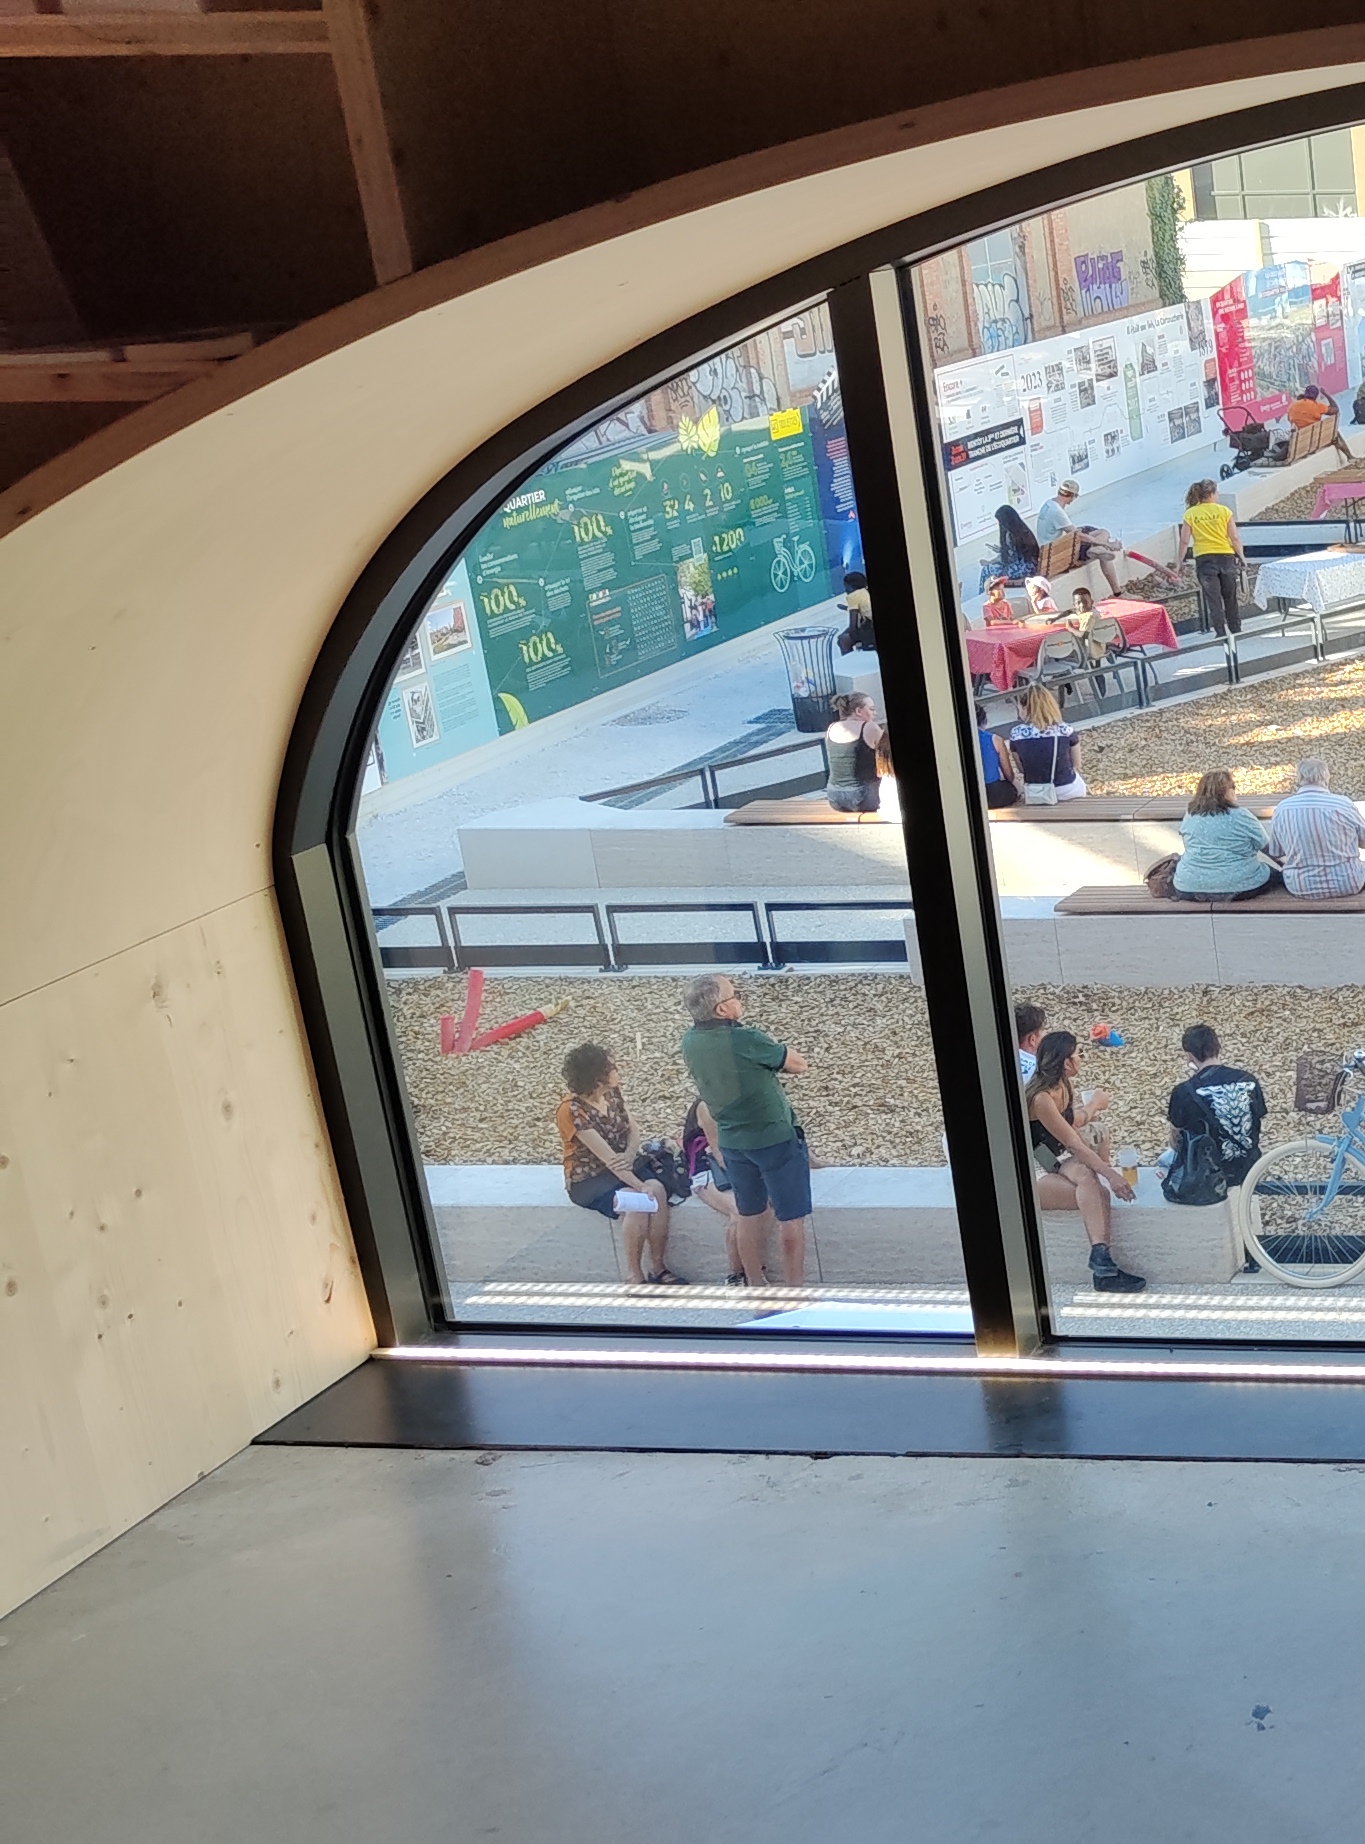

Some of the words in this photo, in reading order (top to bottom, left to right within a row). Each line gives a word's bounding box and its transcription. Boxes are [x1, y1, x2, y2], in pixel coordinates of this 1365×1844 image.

[1021, 370, 1043, 393] 2023
[503, 490, 547, 513] QUARTIER
[684, 494, 695, 512] 4
[703, 488, 714, 507] 2
[719, 482, 733, 501] 10
[502, 498, 563, 530] naturellement
[572, 513, 613, 543] 100%
[480, 584, 527, 617] 100%
[518, 631, 564, 665] 100%
